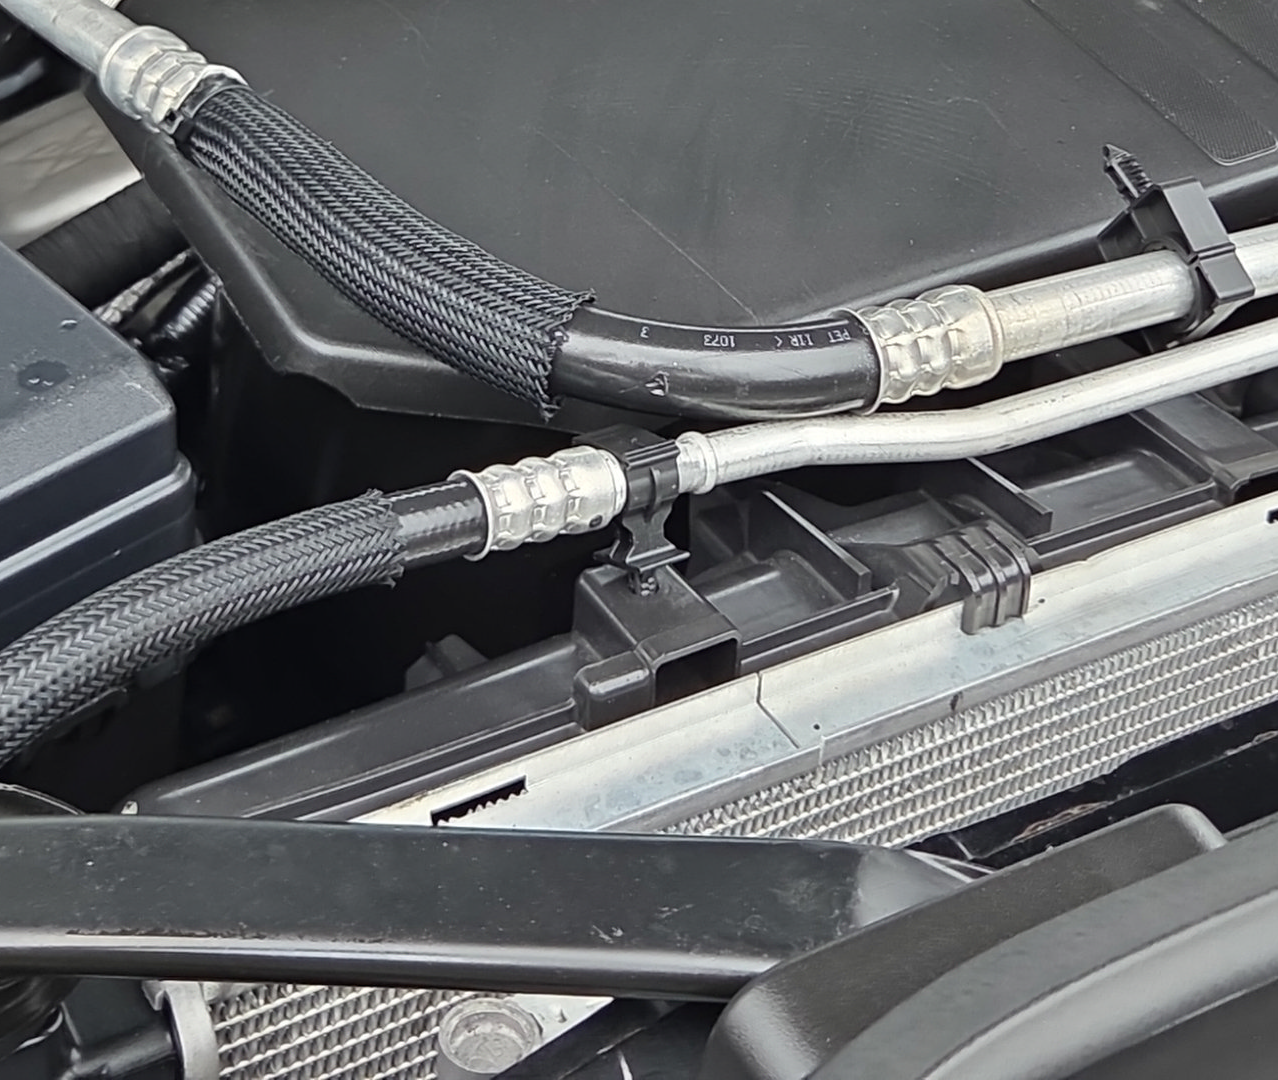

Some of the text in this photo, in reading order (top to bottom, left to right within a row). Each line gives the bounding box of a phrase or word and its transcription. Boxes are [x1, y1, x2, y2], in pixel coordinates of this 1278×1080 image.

[639, 325, 651, 339] 3
[827, 324, 850, 342] PET
[703, 333, 736, 349] 1073
